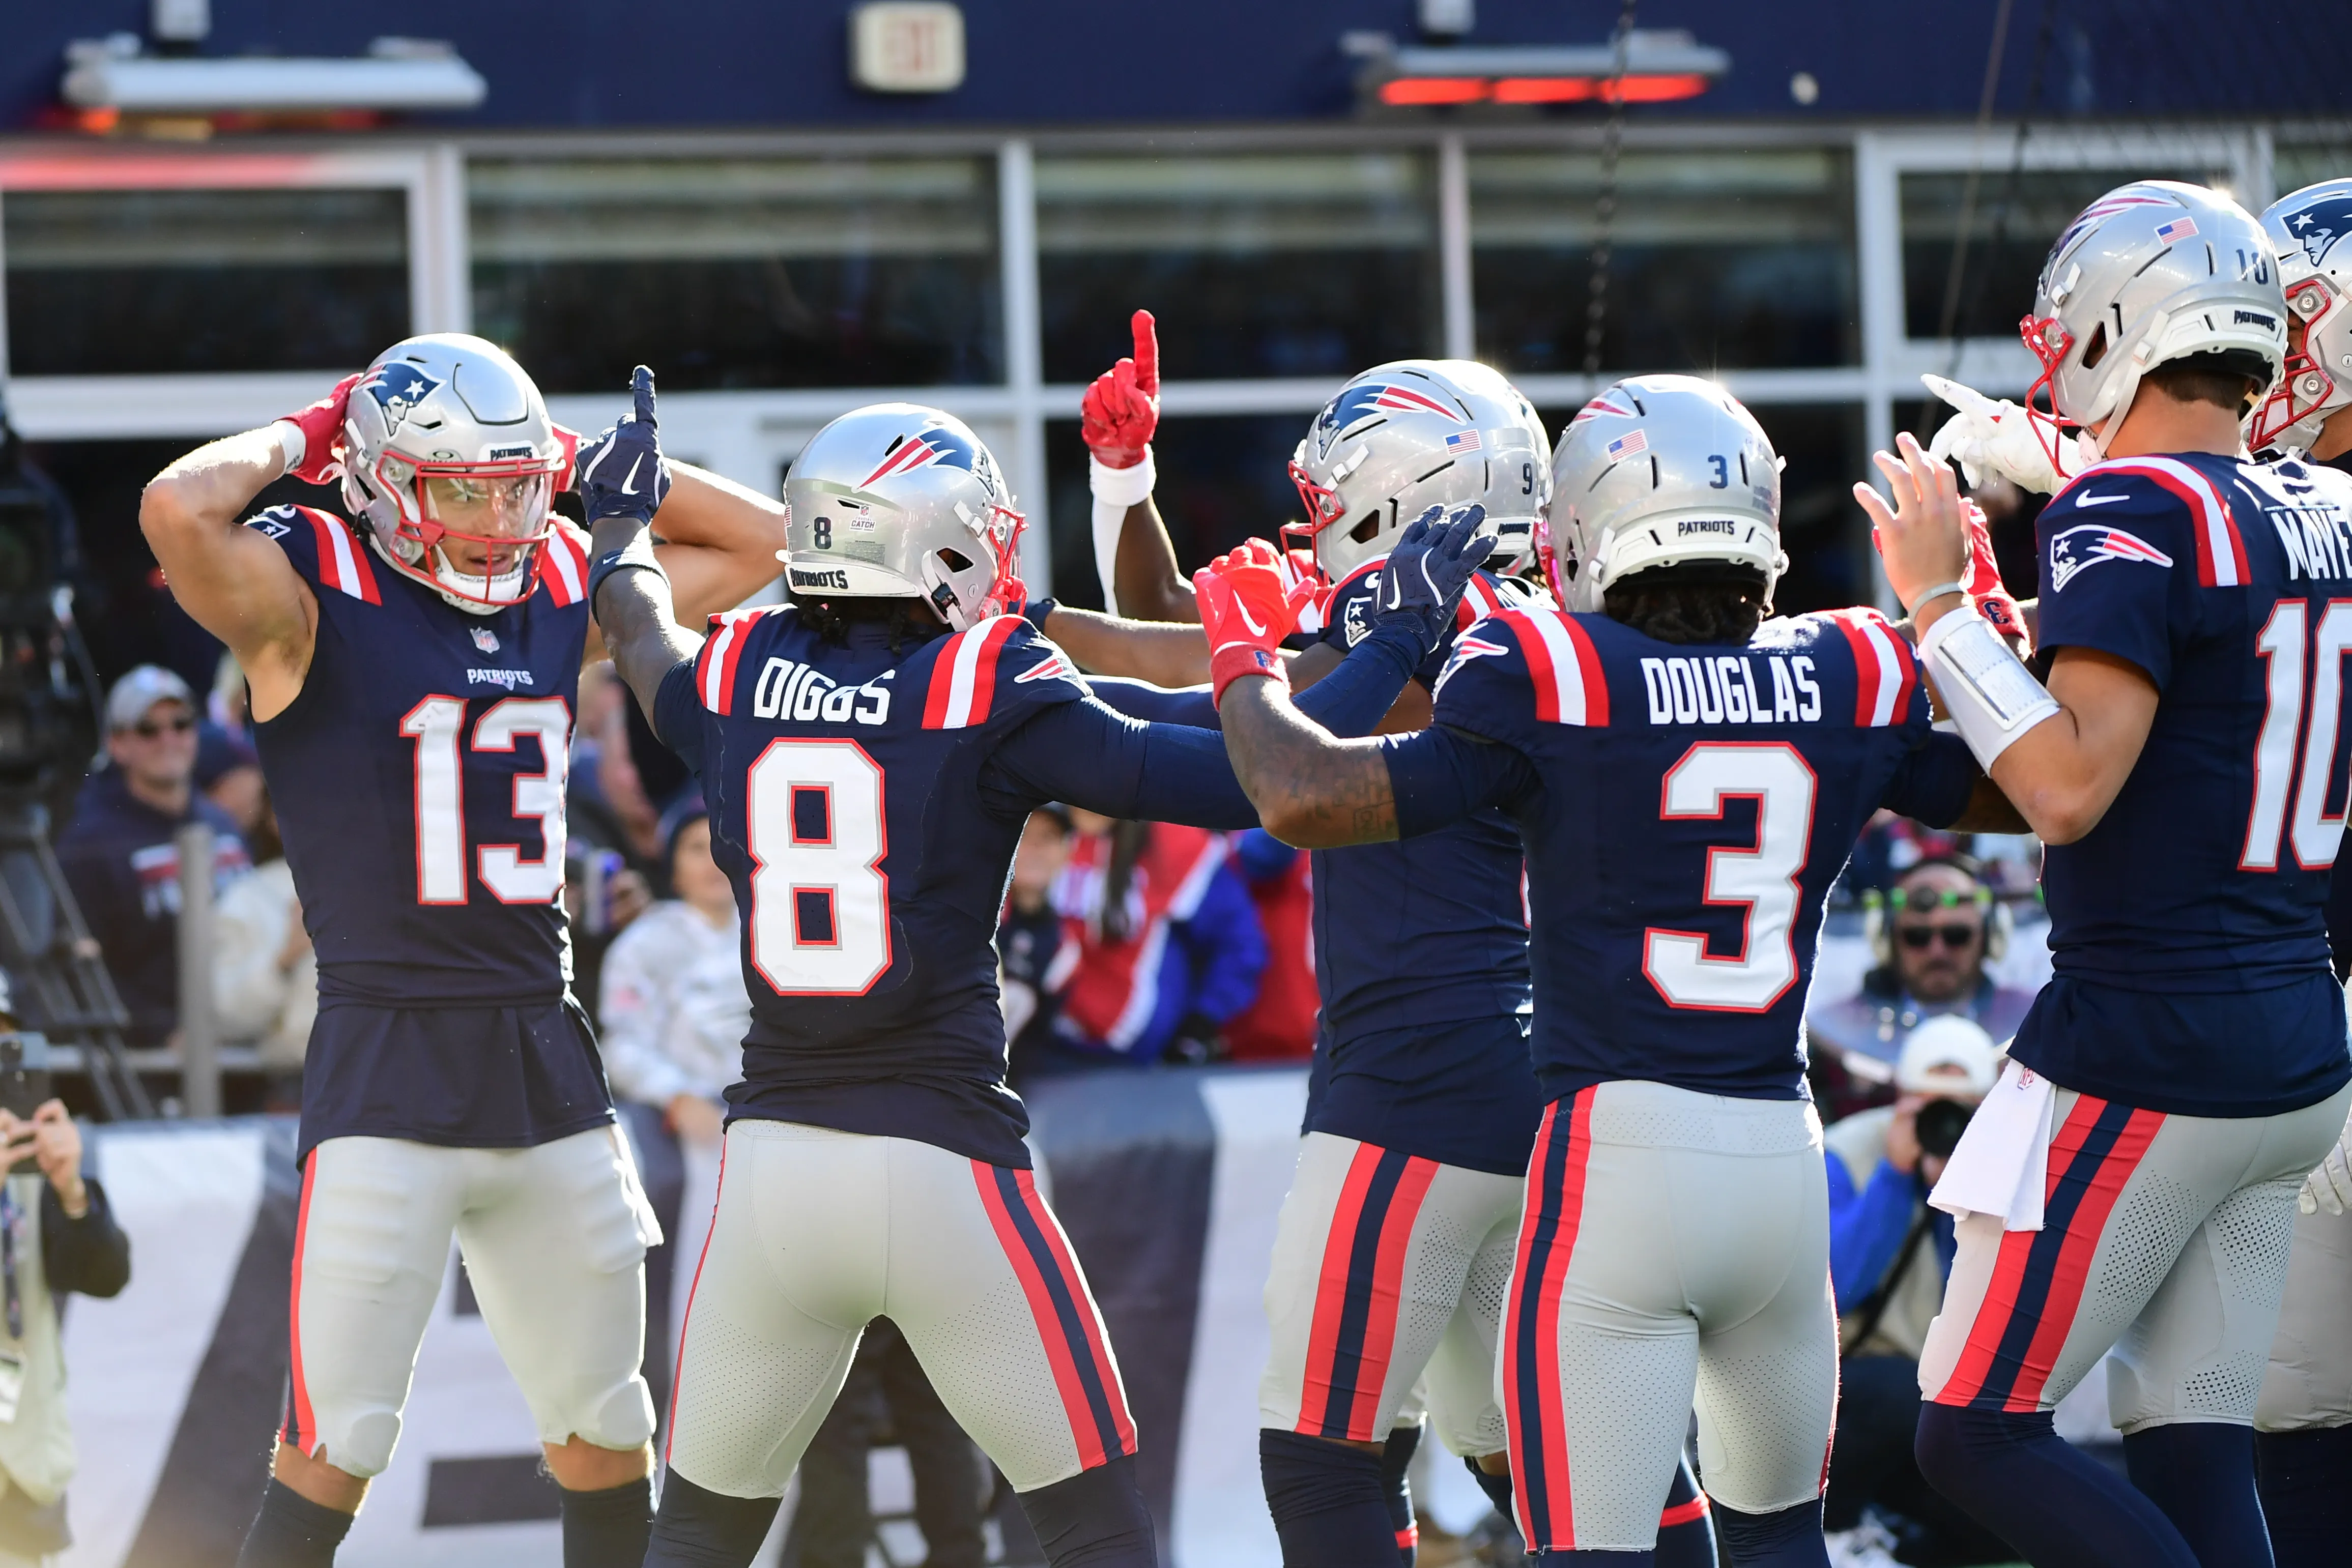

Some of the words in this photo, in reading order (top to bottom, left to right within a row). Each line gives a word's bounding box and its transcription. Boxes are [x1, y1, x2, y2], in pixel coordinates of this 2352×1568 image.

[2235, 249, 2268, 285] 10
[2234, 310, 2276, 332] PATRIOTS
[490, 446, 533, 461] PATRIOTS
[1522, 462, 1533, 495] 9
[1707, 455, 1729, 489] 3
[814, 516, 832, 550] 8
[851, 520, 875, 529] CATCH
[1678, 520, 1735, 537] PATRIOTS
[789, 567, 848, 590] PATRIOTS
[467, 669, 534, 686] PATRIOTS
[754, 656, 896, 725] DIGGS
[1640, 656, 1822, 725] DOUGLAS
[399, 693, 572, 905] 13
[746, 737, 893, 996] 8
[1642, 740, 1818, 1013] 3
